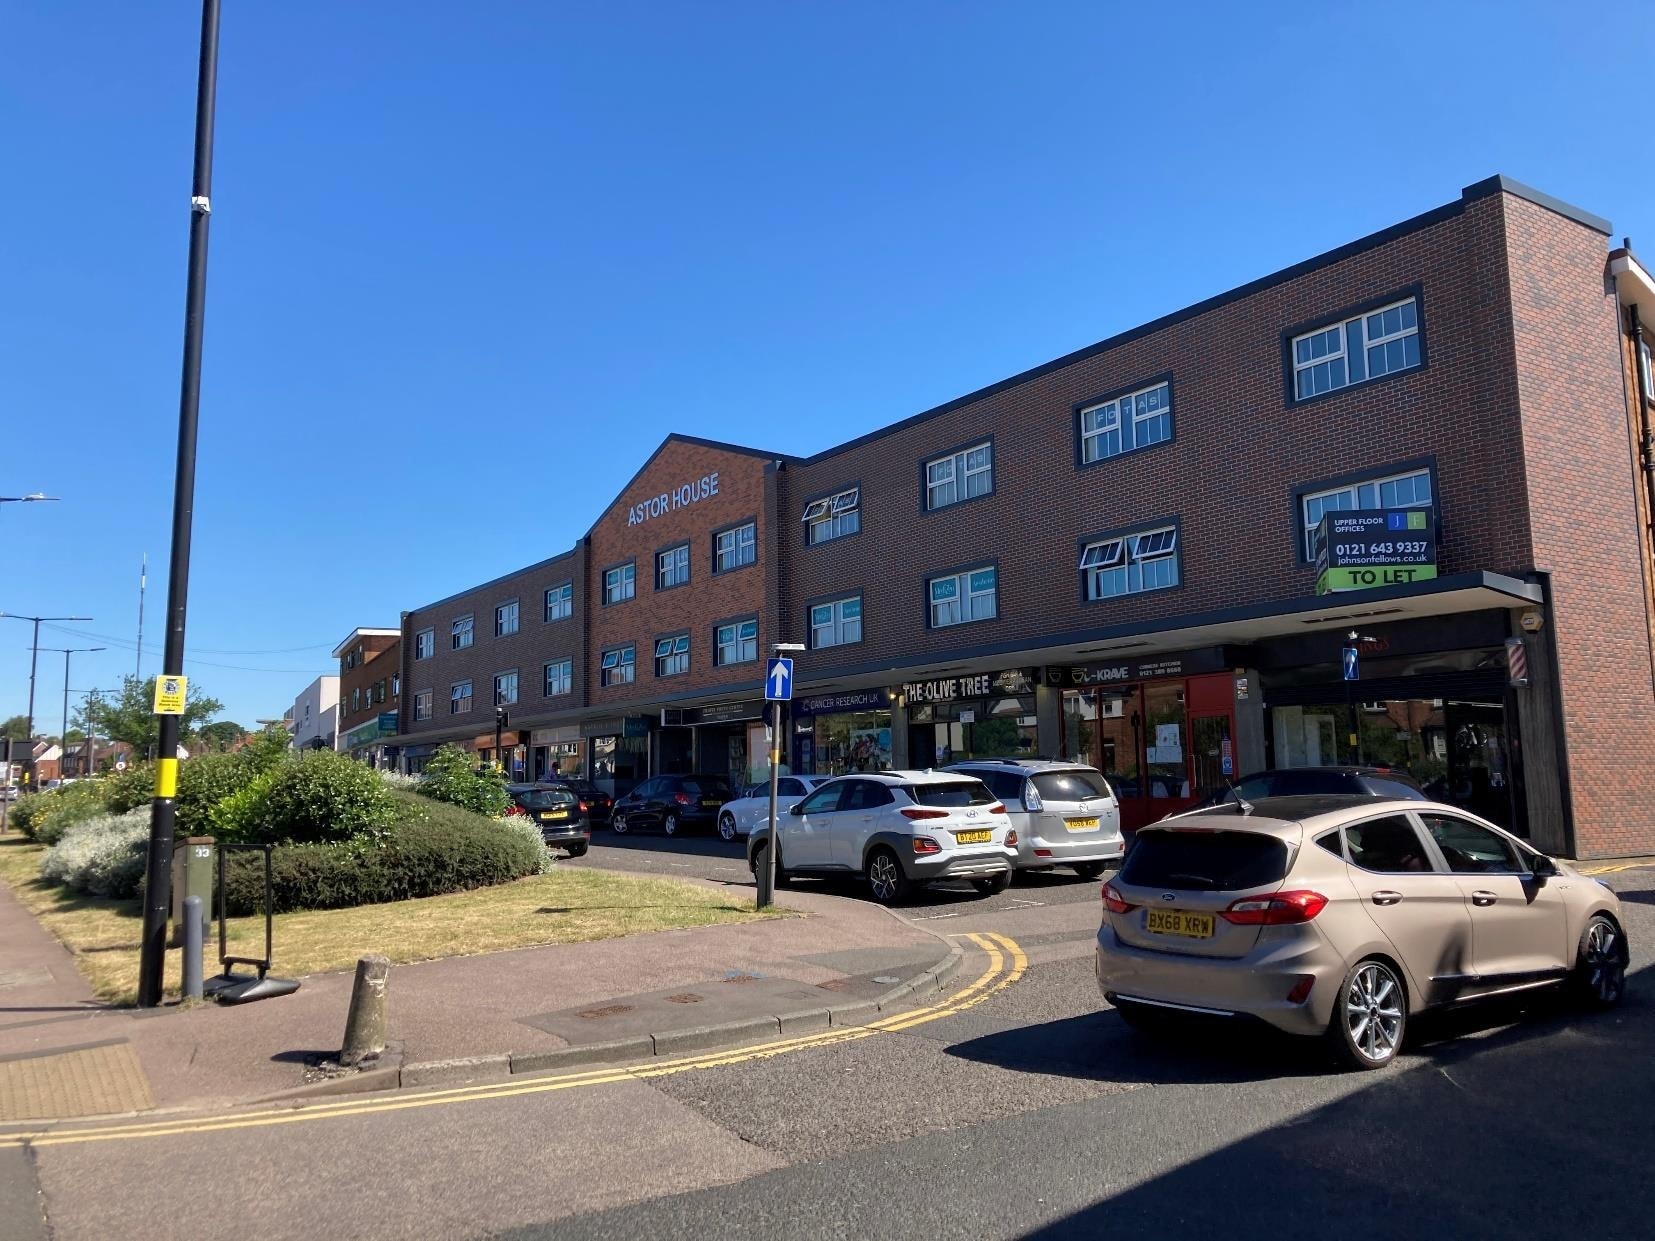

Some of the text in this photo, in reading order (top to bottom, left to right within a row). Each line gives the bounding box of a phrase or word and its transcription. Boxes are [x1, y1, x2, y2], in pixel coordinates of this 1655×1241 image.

[628, 472, 719, 527] ASTOR HOUSE
[1334, 517, 1384, 526] UPPER FLOOR
[1335, 525, 1365, 533] OFFICES
[1336, 541, 1427, 556] 0121 643 9337
[1337, 554, 1428, 566] johnsonfellows.co.uk
[1348, 569, 1416, 585] TO LET
[903, 675, 989, 702] THE OLIVE TREE
[810, 693, 879, 710] CANCER RESEARCH UK
[195, 848, 210, 858] 33
[1149, 912, 1209, 934] BX68 XRW
